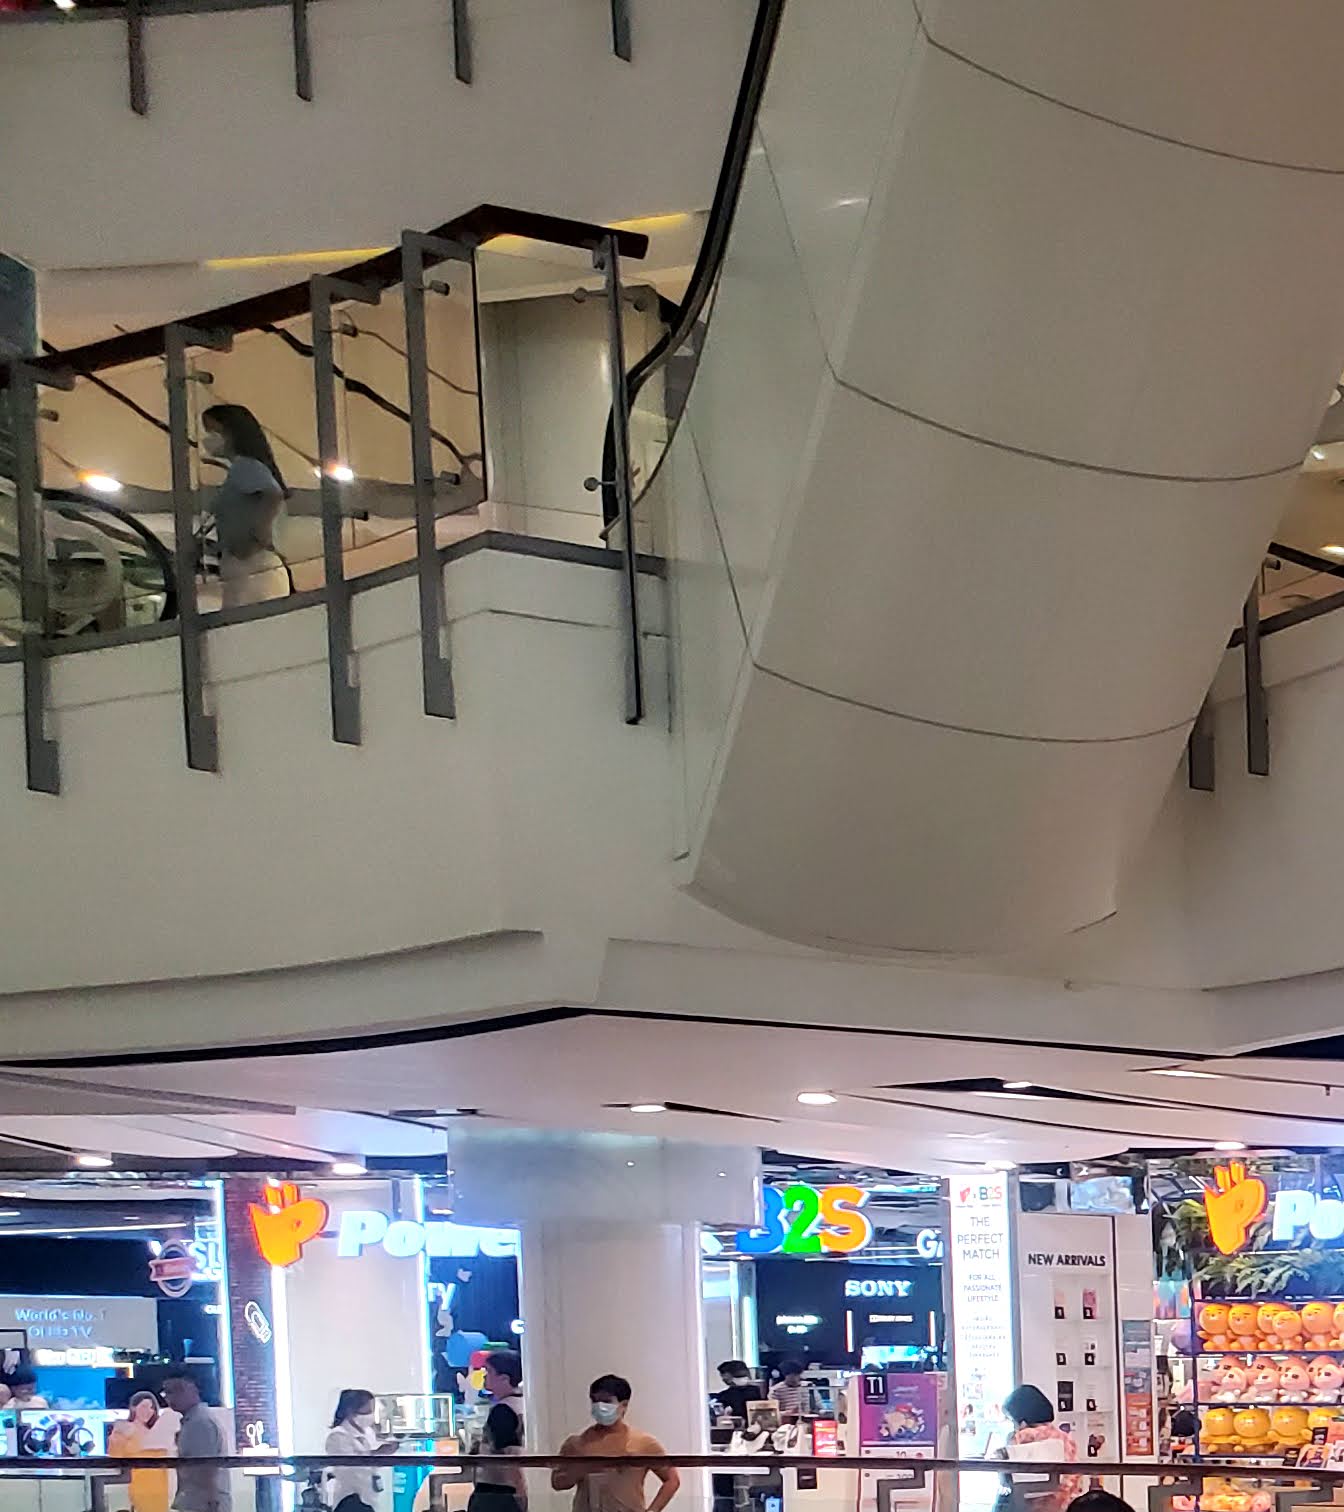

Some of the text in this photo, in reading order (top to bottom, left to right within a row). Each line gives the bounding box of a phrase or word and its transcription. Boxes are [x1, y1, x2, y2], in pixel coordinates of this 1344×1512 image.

[970, 1216, 991, 1227] THE
[957, 1233, 1004, 1245] PERFECT
[963, 1249, 1000, 1261] MATCH
[1028, 1253, 1106, 1267] NEW ARRIVALS
[844, 1280, 913, 1297] SONY
